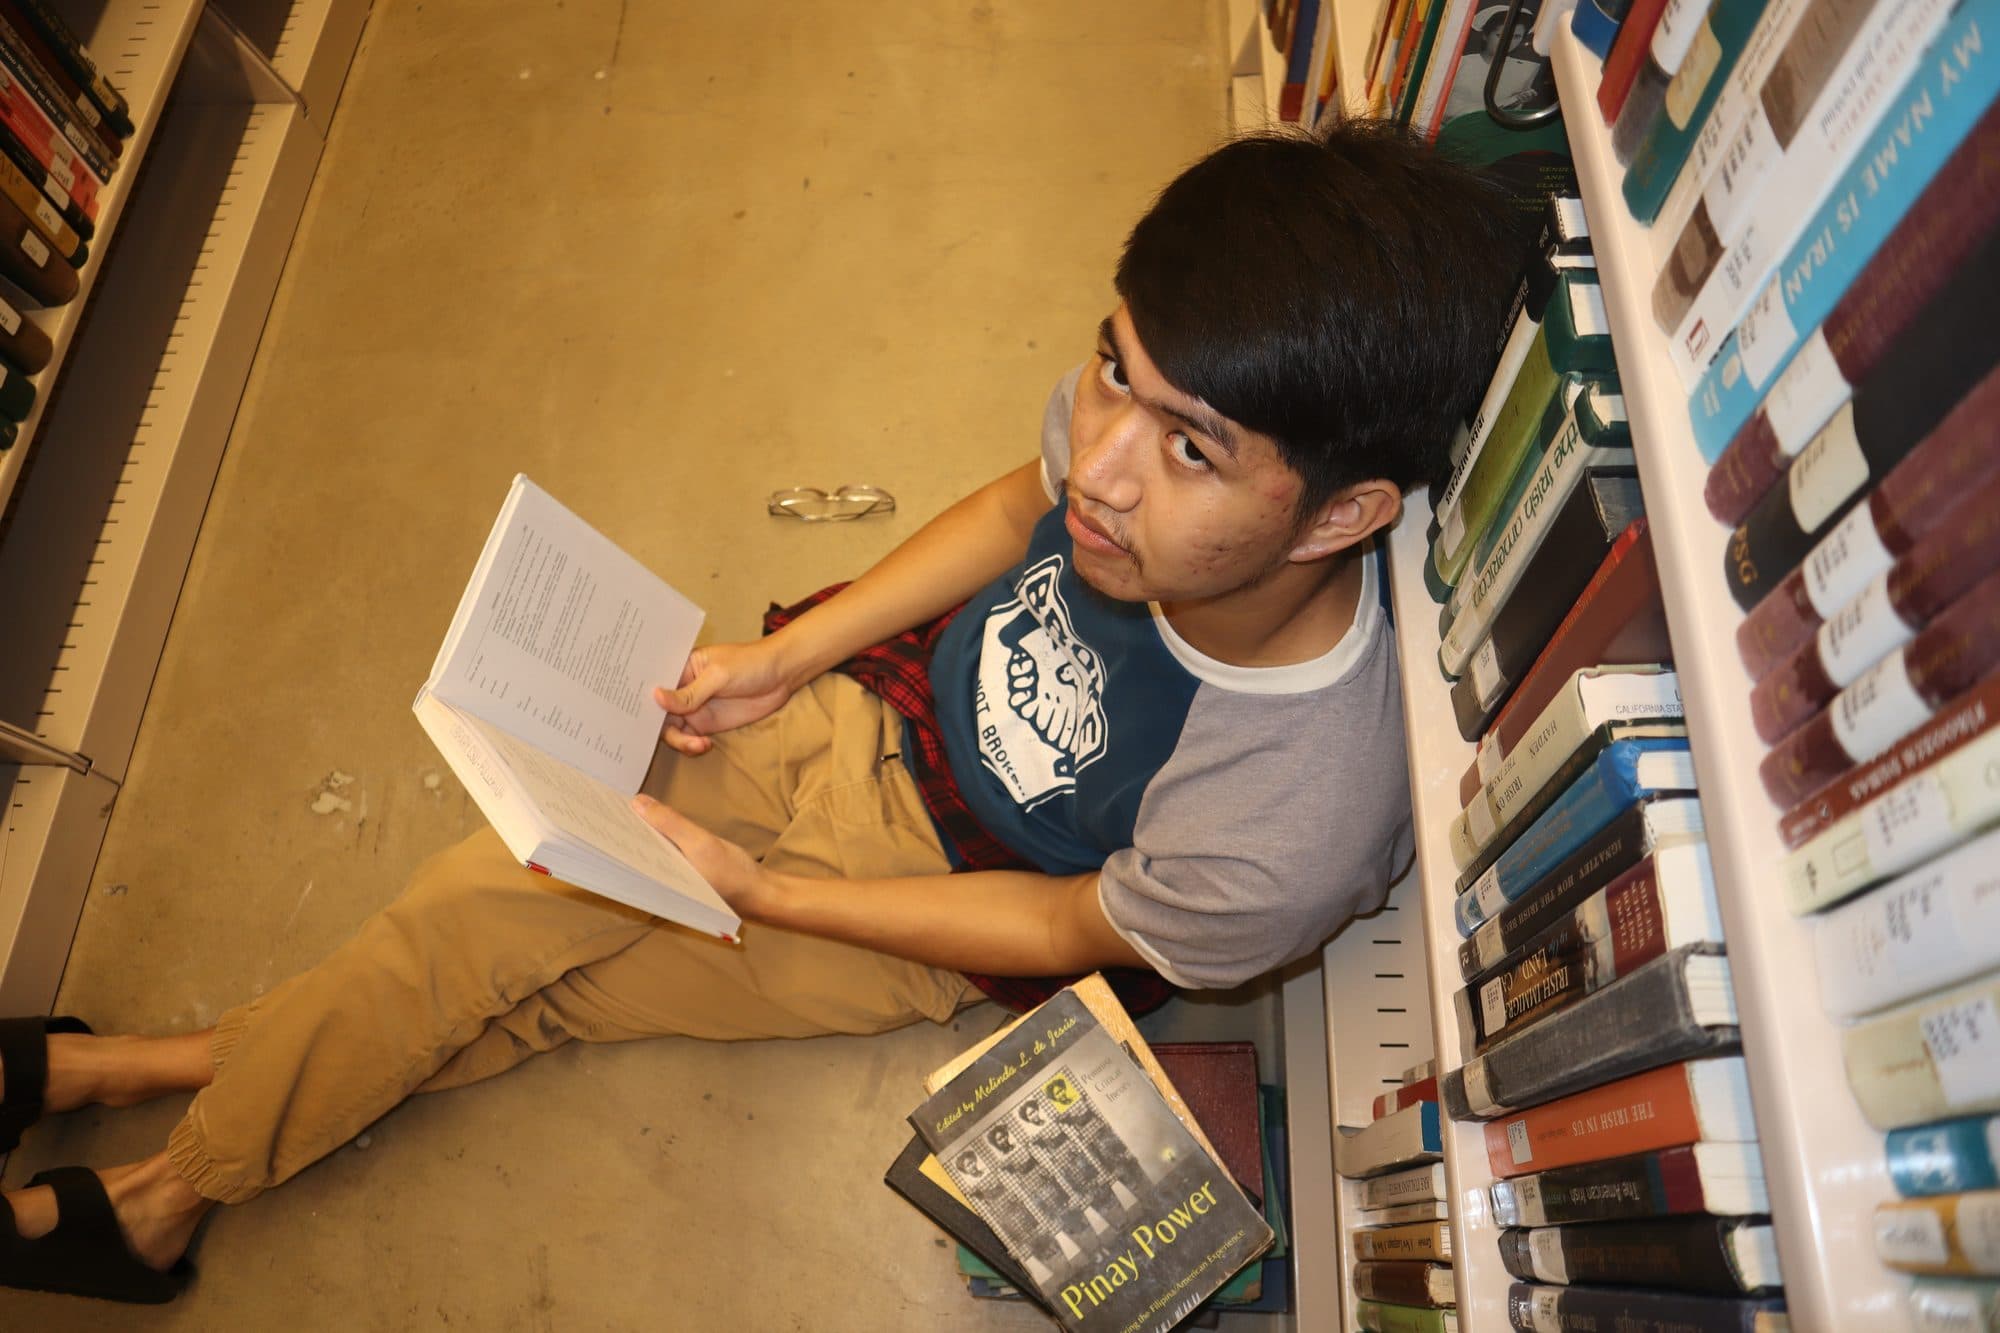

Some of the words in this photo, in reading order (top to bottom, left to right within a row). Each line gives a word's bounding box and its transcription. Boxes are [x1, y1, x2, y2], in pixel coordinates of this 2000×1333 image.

[1940, 19, 1984, 98] MY
[1861, 87, 1935, 200] NAME
[1836, 191, 1862, 232] IS
[1783, 230, 1836, 305] IRAN
[1470, 412, 1486, 448] IRISH
[1553, 421, 1579, 469] the
[1445, 443, 1474, 506] AMERICANS
[1528, 720, 1558, 759] HAYDEN
[1504, 776, 1524, 800] IRISH
[1540, 888, 1557, 909] THE
[1521, 946, 1548, 980] LAND
[1543, 965, 1569, 1000] IRISH
[935, 1106, 963, 1134] Edited
[960, 1099, 976, 1119] by
[973, 1063, 1017, 1102] Melinda
[1032, 1037, 1048, 1054] de
[1571, 1119, 1586, 1136] US
[1585, 1115, 1599, 1133] IN
[1599, 1107, 1630, 1130] IRISH
[1630, 1101, 1656, 1122] THE
[1622, 1181, 1640, 1201] The
[1060, 1250, 1140, 1320] Pinay
[1131, 1180, 1218, 1259] Power
[1138, 1310, 1151, 1325] the
[1206, 1229, 1247, 1264] Experience
